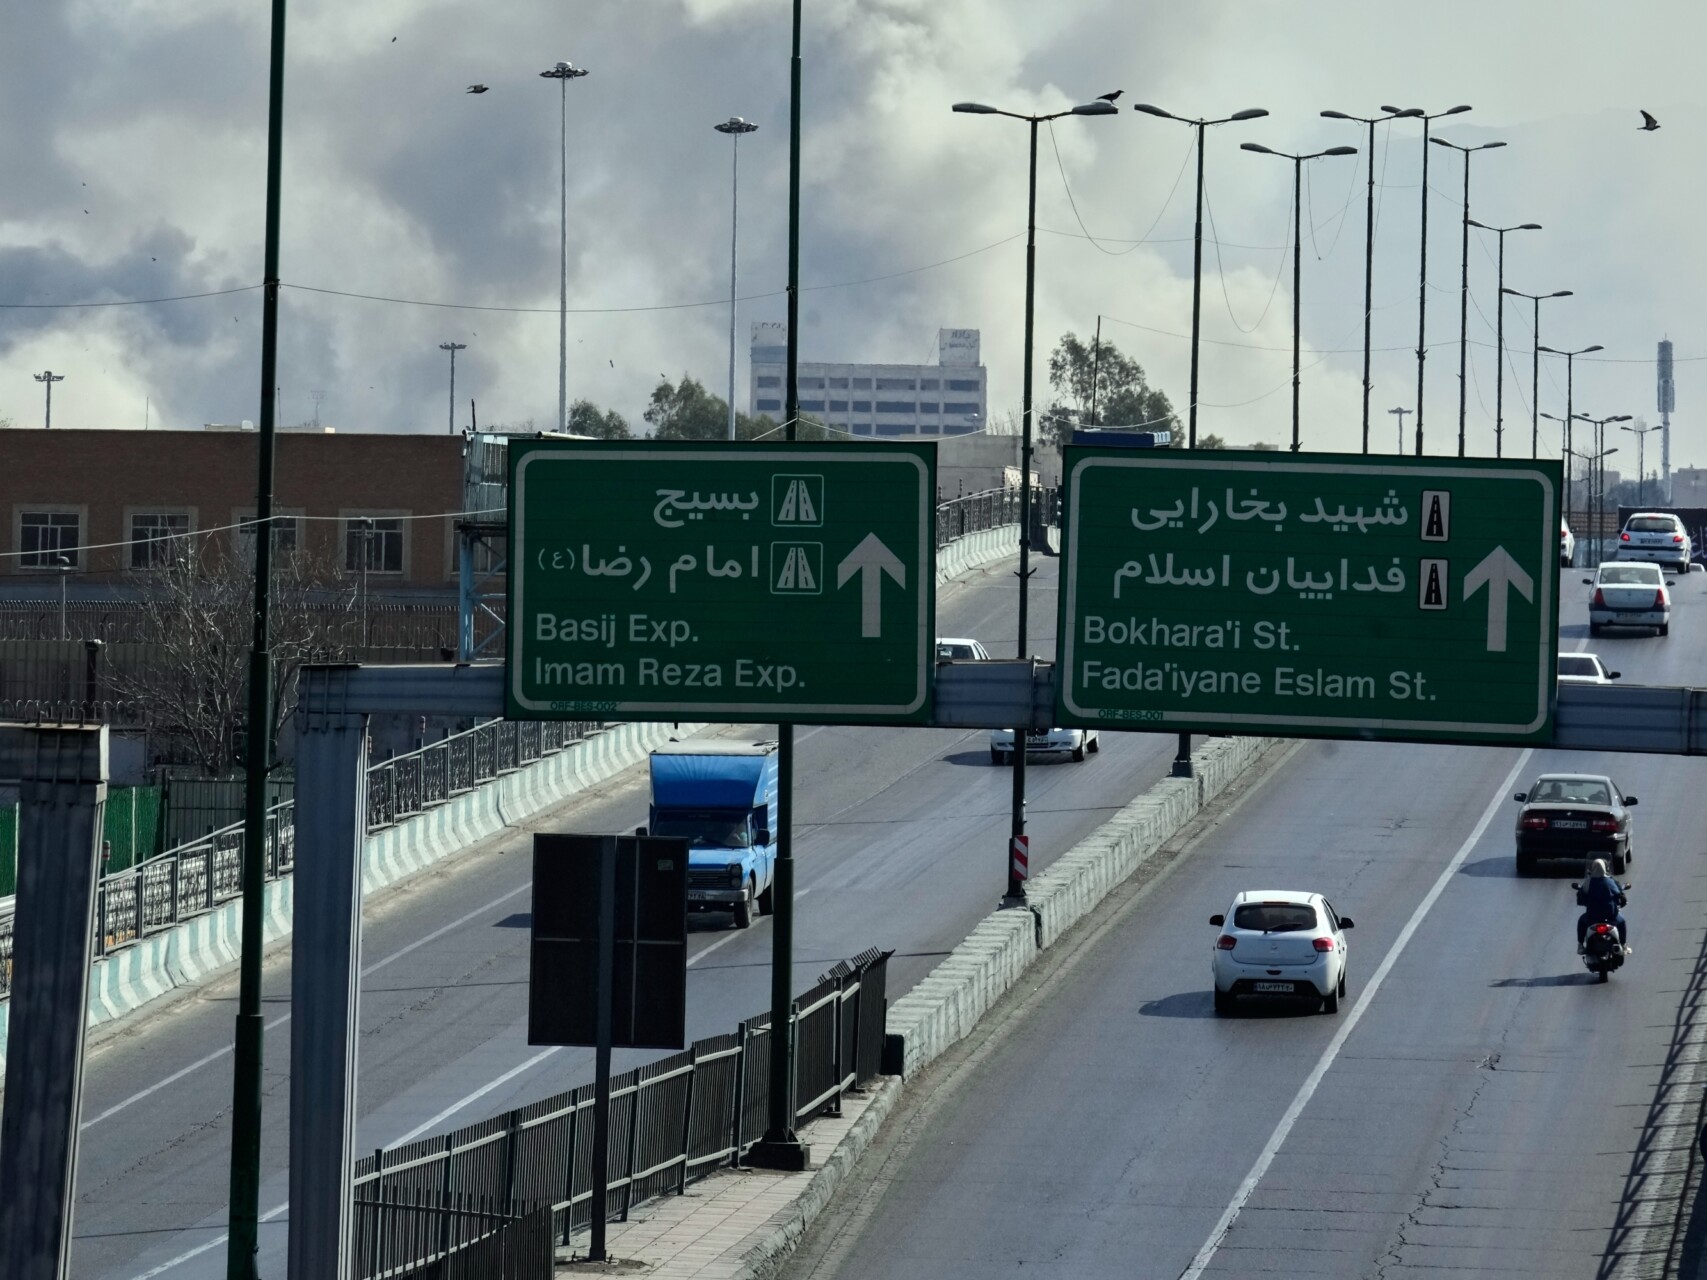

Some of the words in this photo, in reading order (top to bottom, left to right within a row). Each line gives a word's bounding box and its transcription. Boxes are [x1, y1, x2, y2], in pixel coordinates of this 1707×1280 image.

[653, 488, 760, 528] بسیج
[1131, 486, 1288, 535] بخارایی
[1299, 489, 1409, 534] شهید
[581, 543, 652, 592] رضا
[669, 544, 760, 594] امام
[1113, 552, 1230, 600] اسلام
[1246, 556, 1407, 600] فداییان
[536, 613, 616, 648] Basij
[629, 613, 699, 647] Exp.
[1084, 615, 1241, 651] Bokhara'i
[1253, 620, 1300, 651] St.
[535, 657, 625, 686] Imam
[638, 657, 722, 687] Reza
[735, 658, 806, 693] Exp.
[1083, 660, 1261, 699] Fada'iyane
[1275, 667, 1375, 699] Eslam
[1389, 670, 1438, 702] St.
